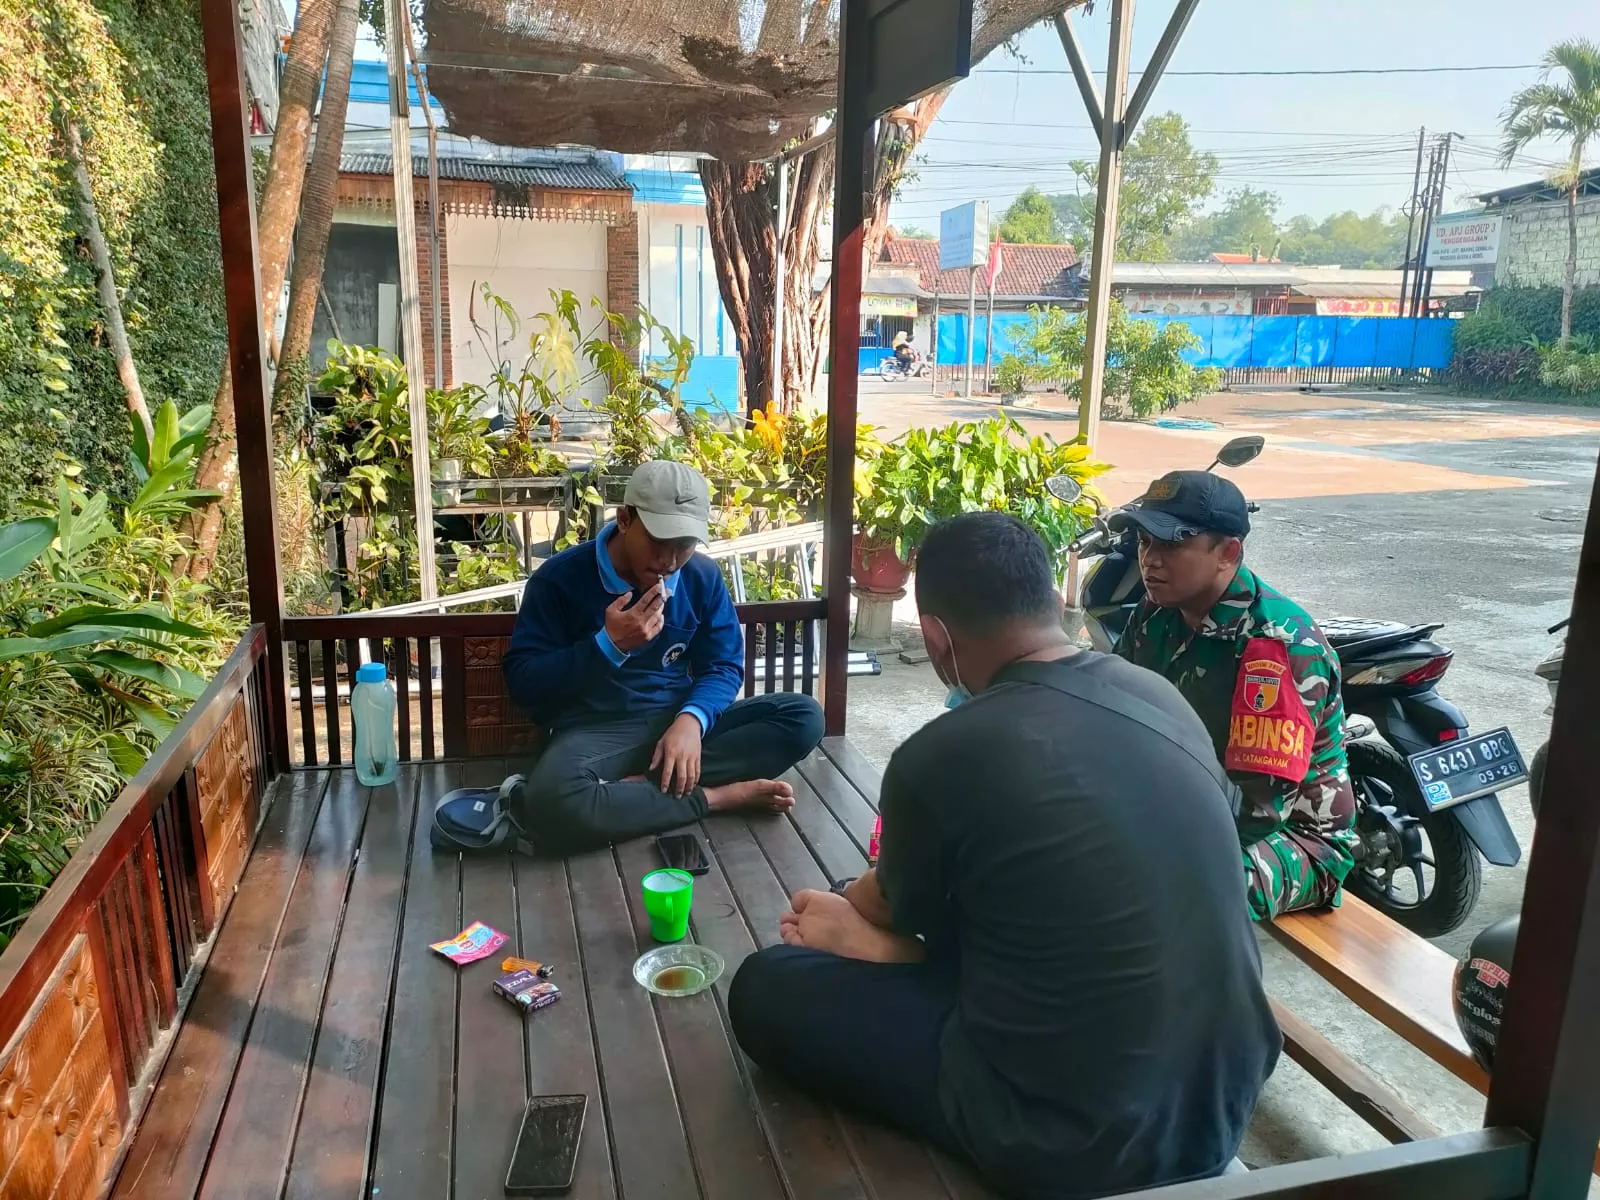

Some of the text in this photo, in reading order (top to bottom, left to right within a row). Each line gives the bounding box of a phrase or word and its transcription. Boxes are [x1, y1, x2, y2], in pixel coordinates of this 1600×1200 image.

[1464, 223, 1490, 235] GROUP
[1231, 715, 1304, 759] ABINSA
[1420, 762, 1433, 781] S
[1438, 748, 1477, 775] 6431
